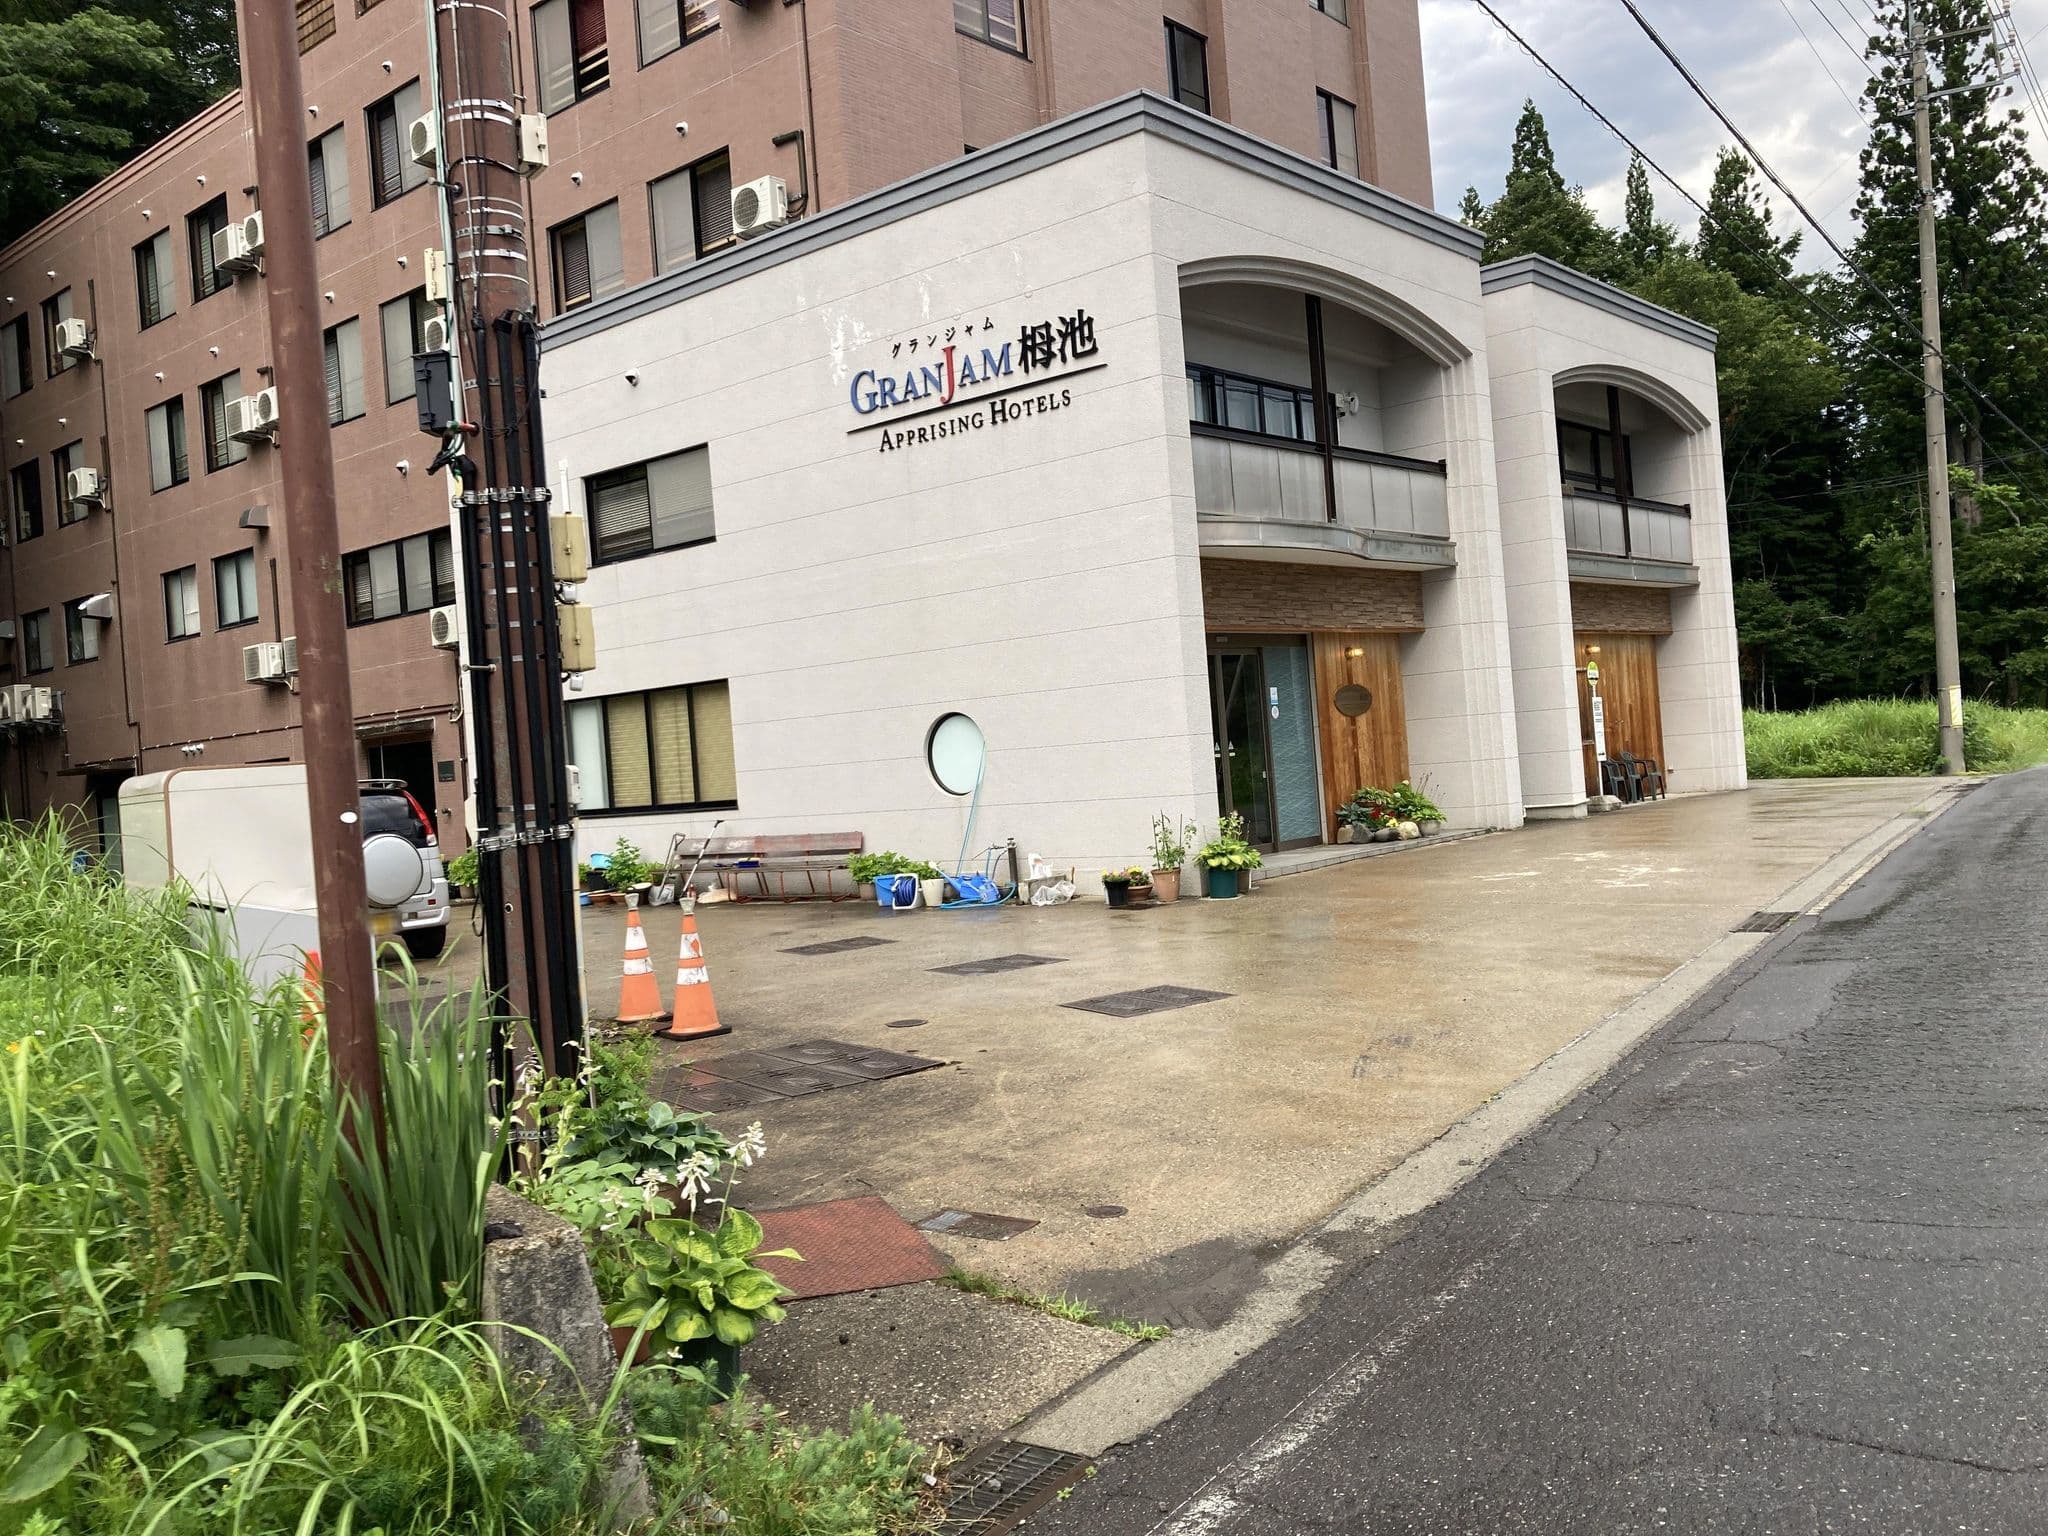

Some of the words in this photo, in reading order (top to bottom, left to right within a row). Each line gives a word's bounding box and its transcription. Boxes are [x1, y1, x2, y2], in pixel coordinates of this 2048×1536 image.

[1018, 309, 1099, 375] 栂池
[879, 413, 985, 452] APPRISING
[989, 389, 1072, 426] HOTELS
